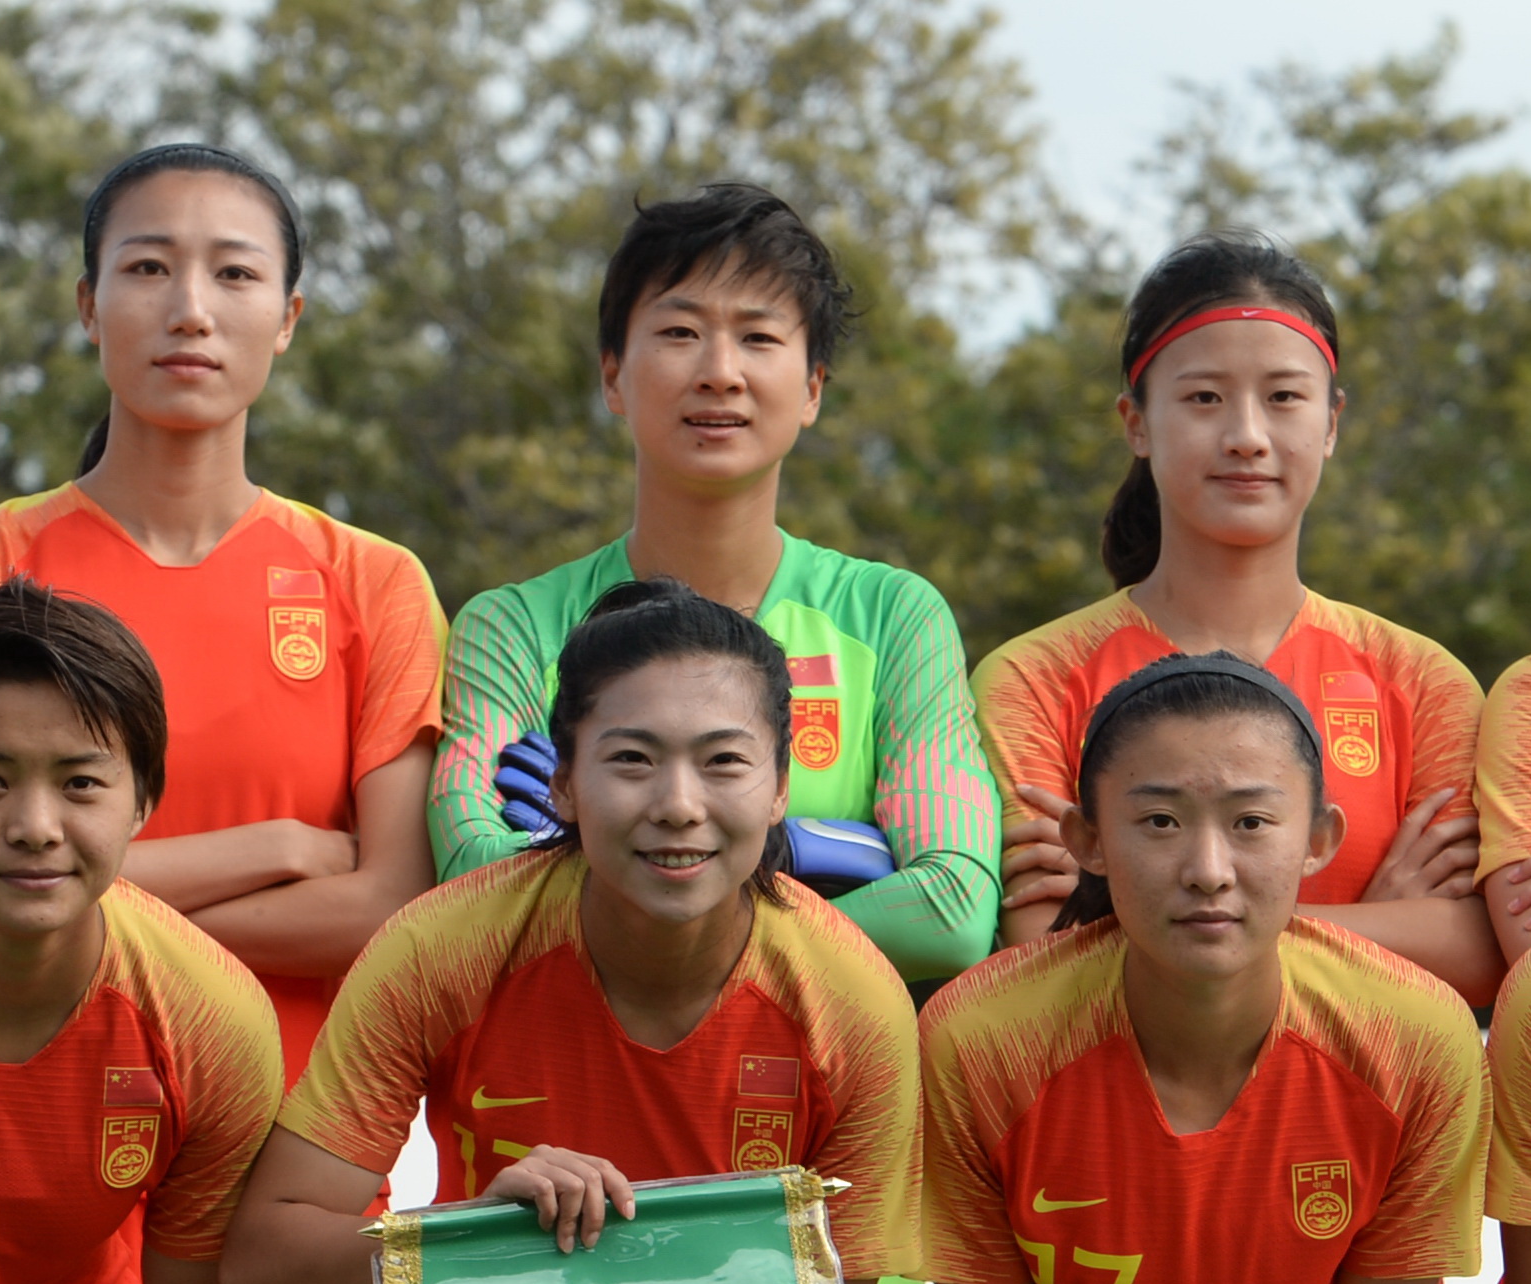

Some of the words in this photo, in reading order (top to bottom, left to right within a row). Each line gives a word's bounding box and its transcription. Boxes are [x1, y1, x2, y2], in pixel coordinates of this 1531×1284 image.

[275, 612, 320, 628] CFA
[791, 702, 836, 716] CFA
[1329, 712, 1373, 728] CFA
[108, 1119, 155, 1136] CFA
[739, 1113, 787, 1130] CFA
[1297, 1165, 1346, 1182] CFA
